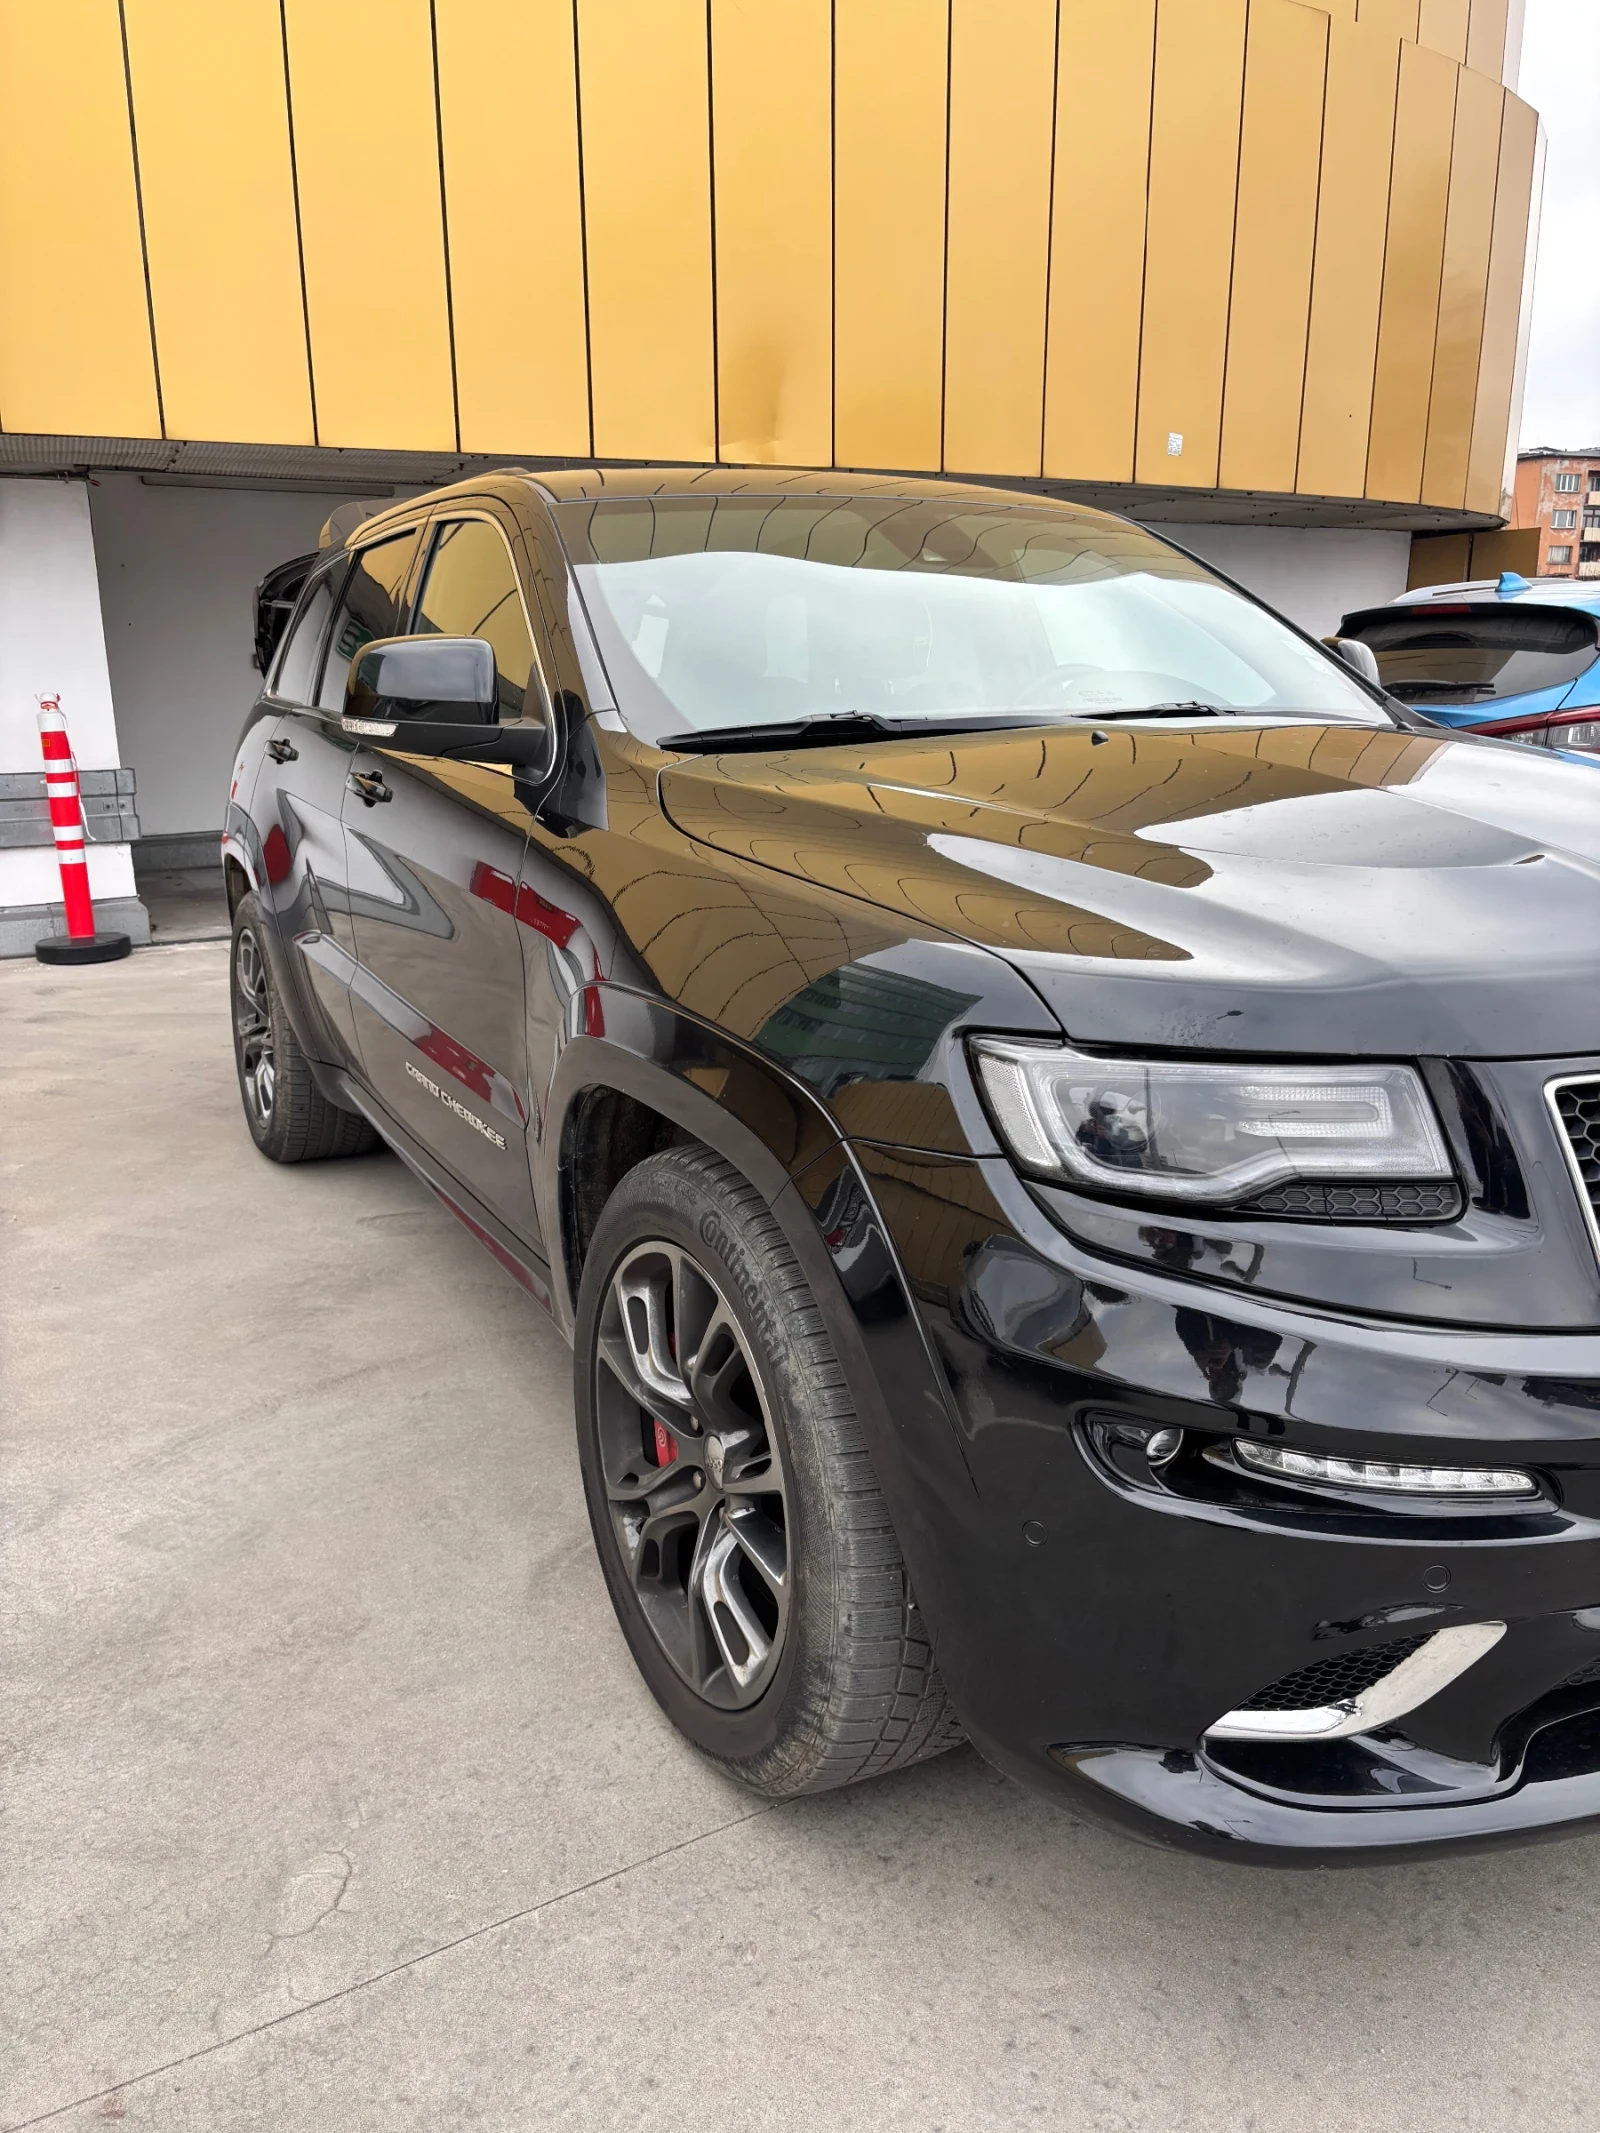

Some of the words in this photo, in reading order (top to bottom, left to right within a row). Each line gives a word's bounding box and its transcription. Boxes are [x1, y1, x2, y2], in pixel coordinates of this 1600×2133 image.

[406, 1061, 439, 1098] GRAND
[441, 1090, 507, 1151] CHEROKEE
[700, 1209, 790, 1371] Continental
